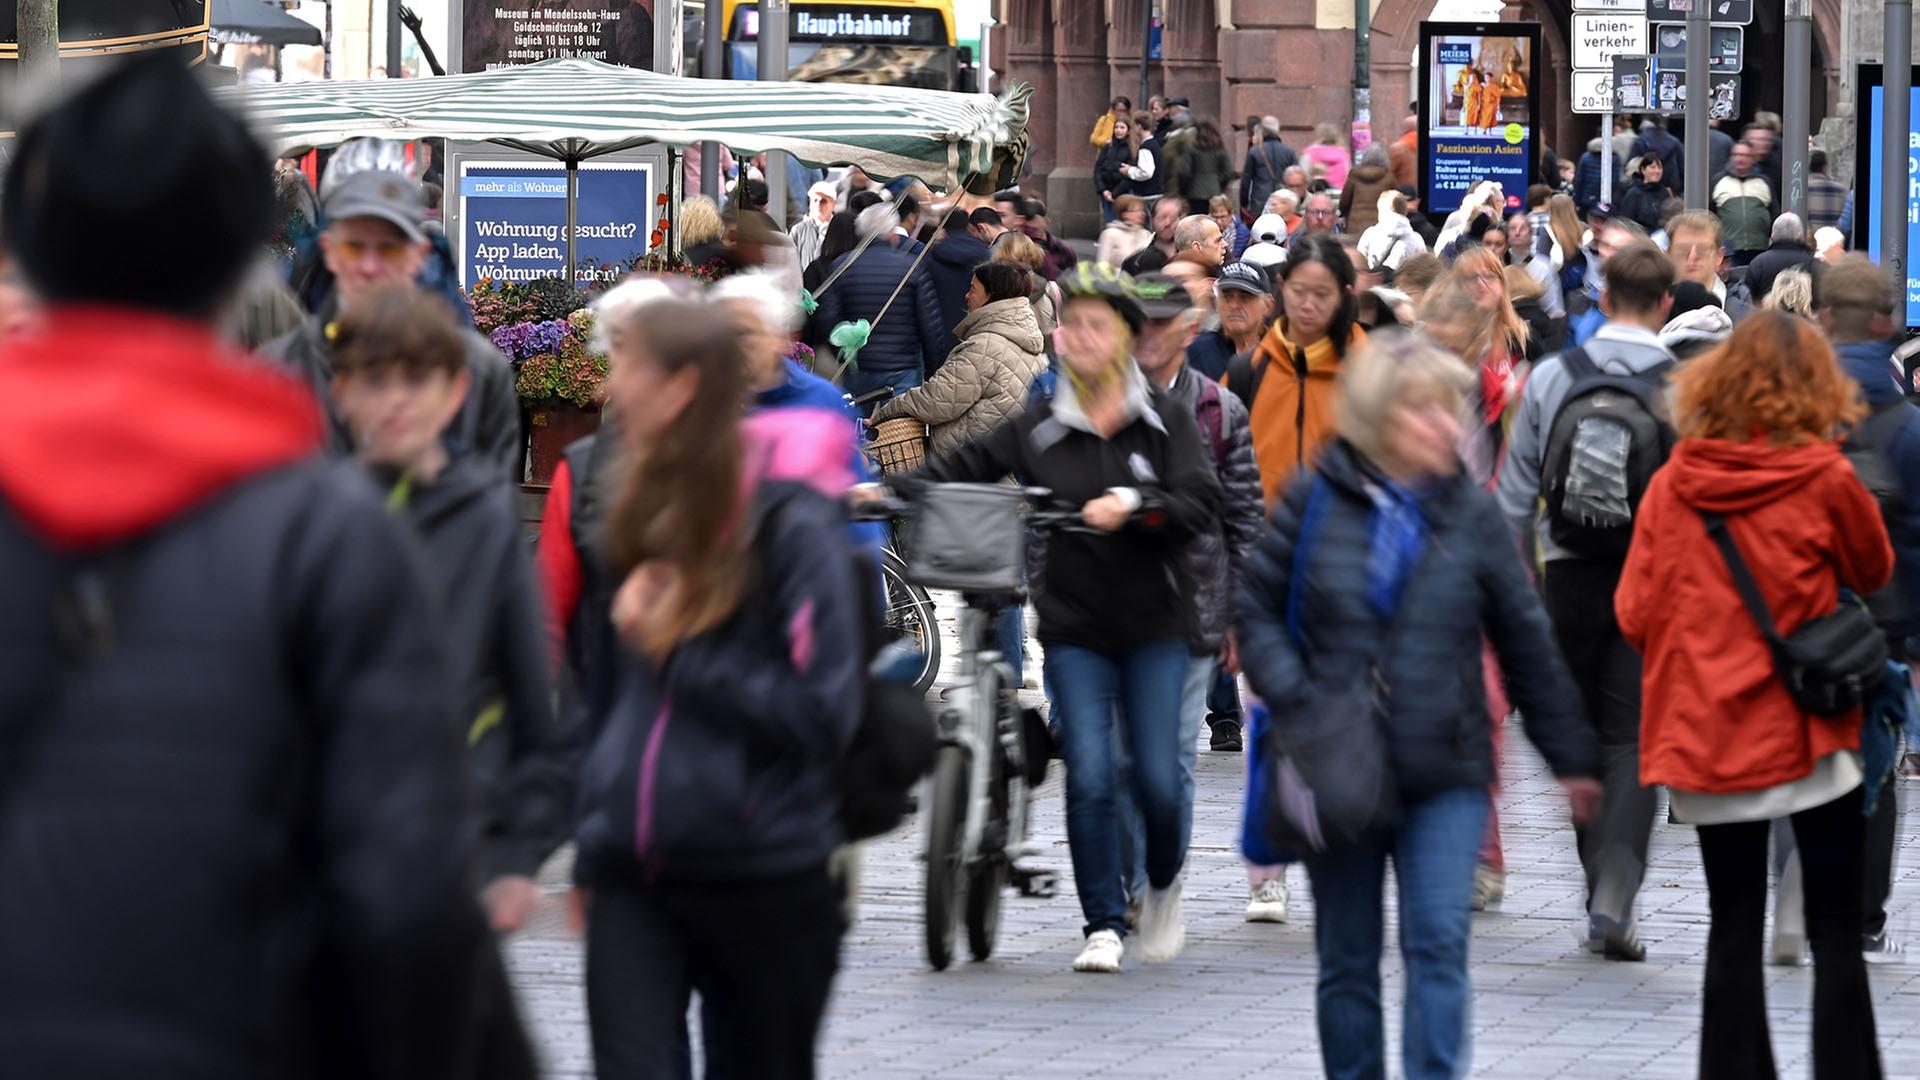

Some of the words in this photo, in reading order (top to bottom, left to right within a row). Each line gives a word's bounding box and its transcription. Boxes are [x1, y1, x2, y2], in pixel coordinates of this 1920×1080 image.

[495, 8, 529, 19] Museum
[531, 9, 541, 19] im
[544, 8, 621, 20] Mendelssohn-Haus
[513, 22, 588, 33] Goldschmidtstraße
[591, 22, 601, 33] 12
[797, 12, 911, 37] Hauptbahnhof
[1586, 20, 1634, 32] Linien-
[514, 35, 542, 47] täglich
[545, 35, 556, 46] 10
[558, 35, 570, 46] bis
[573, 36, 584, 46] 18
[586, 35, 601, 46] Uhr
[1584, 36, 1637, 48] verkehr
[508, 48, 544, 60] sonntags
[547, 48, 557, 59] 11
[560, 48, 574, 59] Uhr
[576, 48, 607, 60] Konzert
[1440, 50, 1469, 58] MEIERS
[1581, 97, 1613, 107] 20-11
[1436, 143, 1492, 154] Faszination
[1494, 144, 1522, 155] Asien
[1435, 165, 1457, 173] Kultur
[1458, 165, 1471, 173] und
[1472, 166, 1490, 174] Natur
[475, 182, 505, 192] mehr
[508, 182, 522, 192] als
[474, 220, 558, 241] Wohnung
[474, 243, 510, 263] App
[512, 243, 563, 262] laden,
